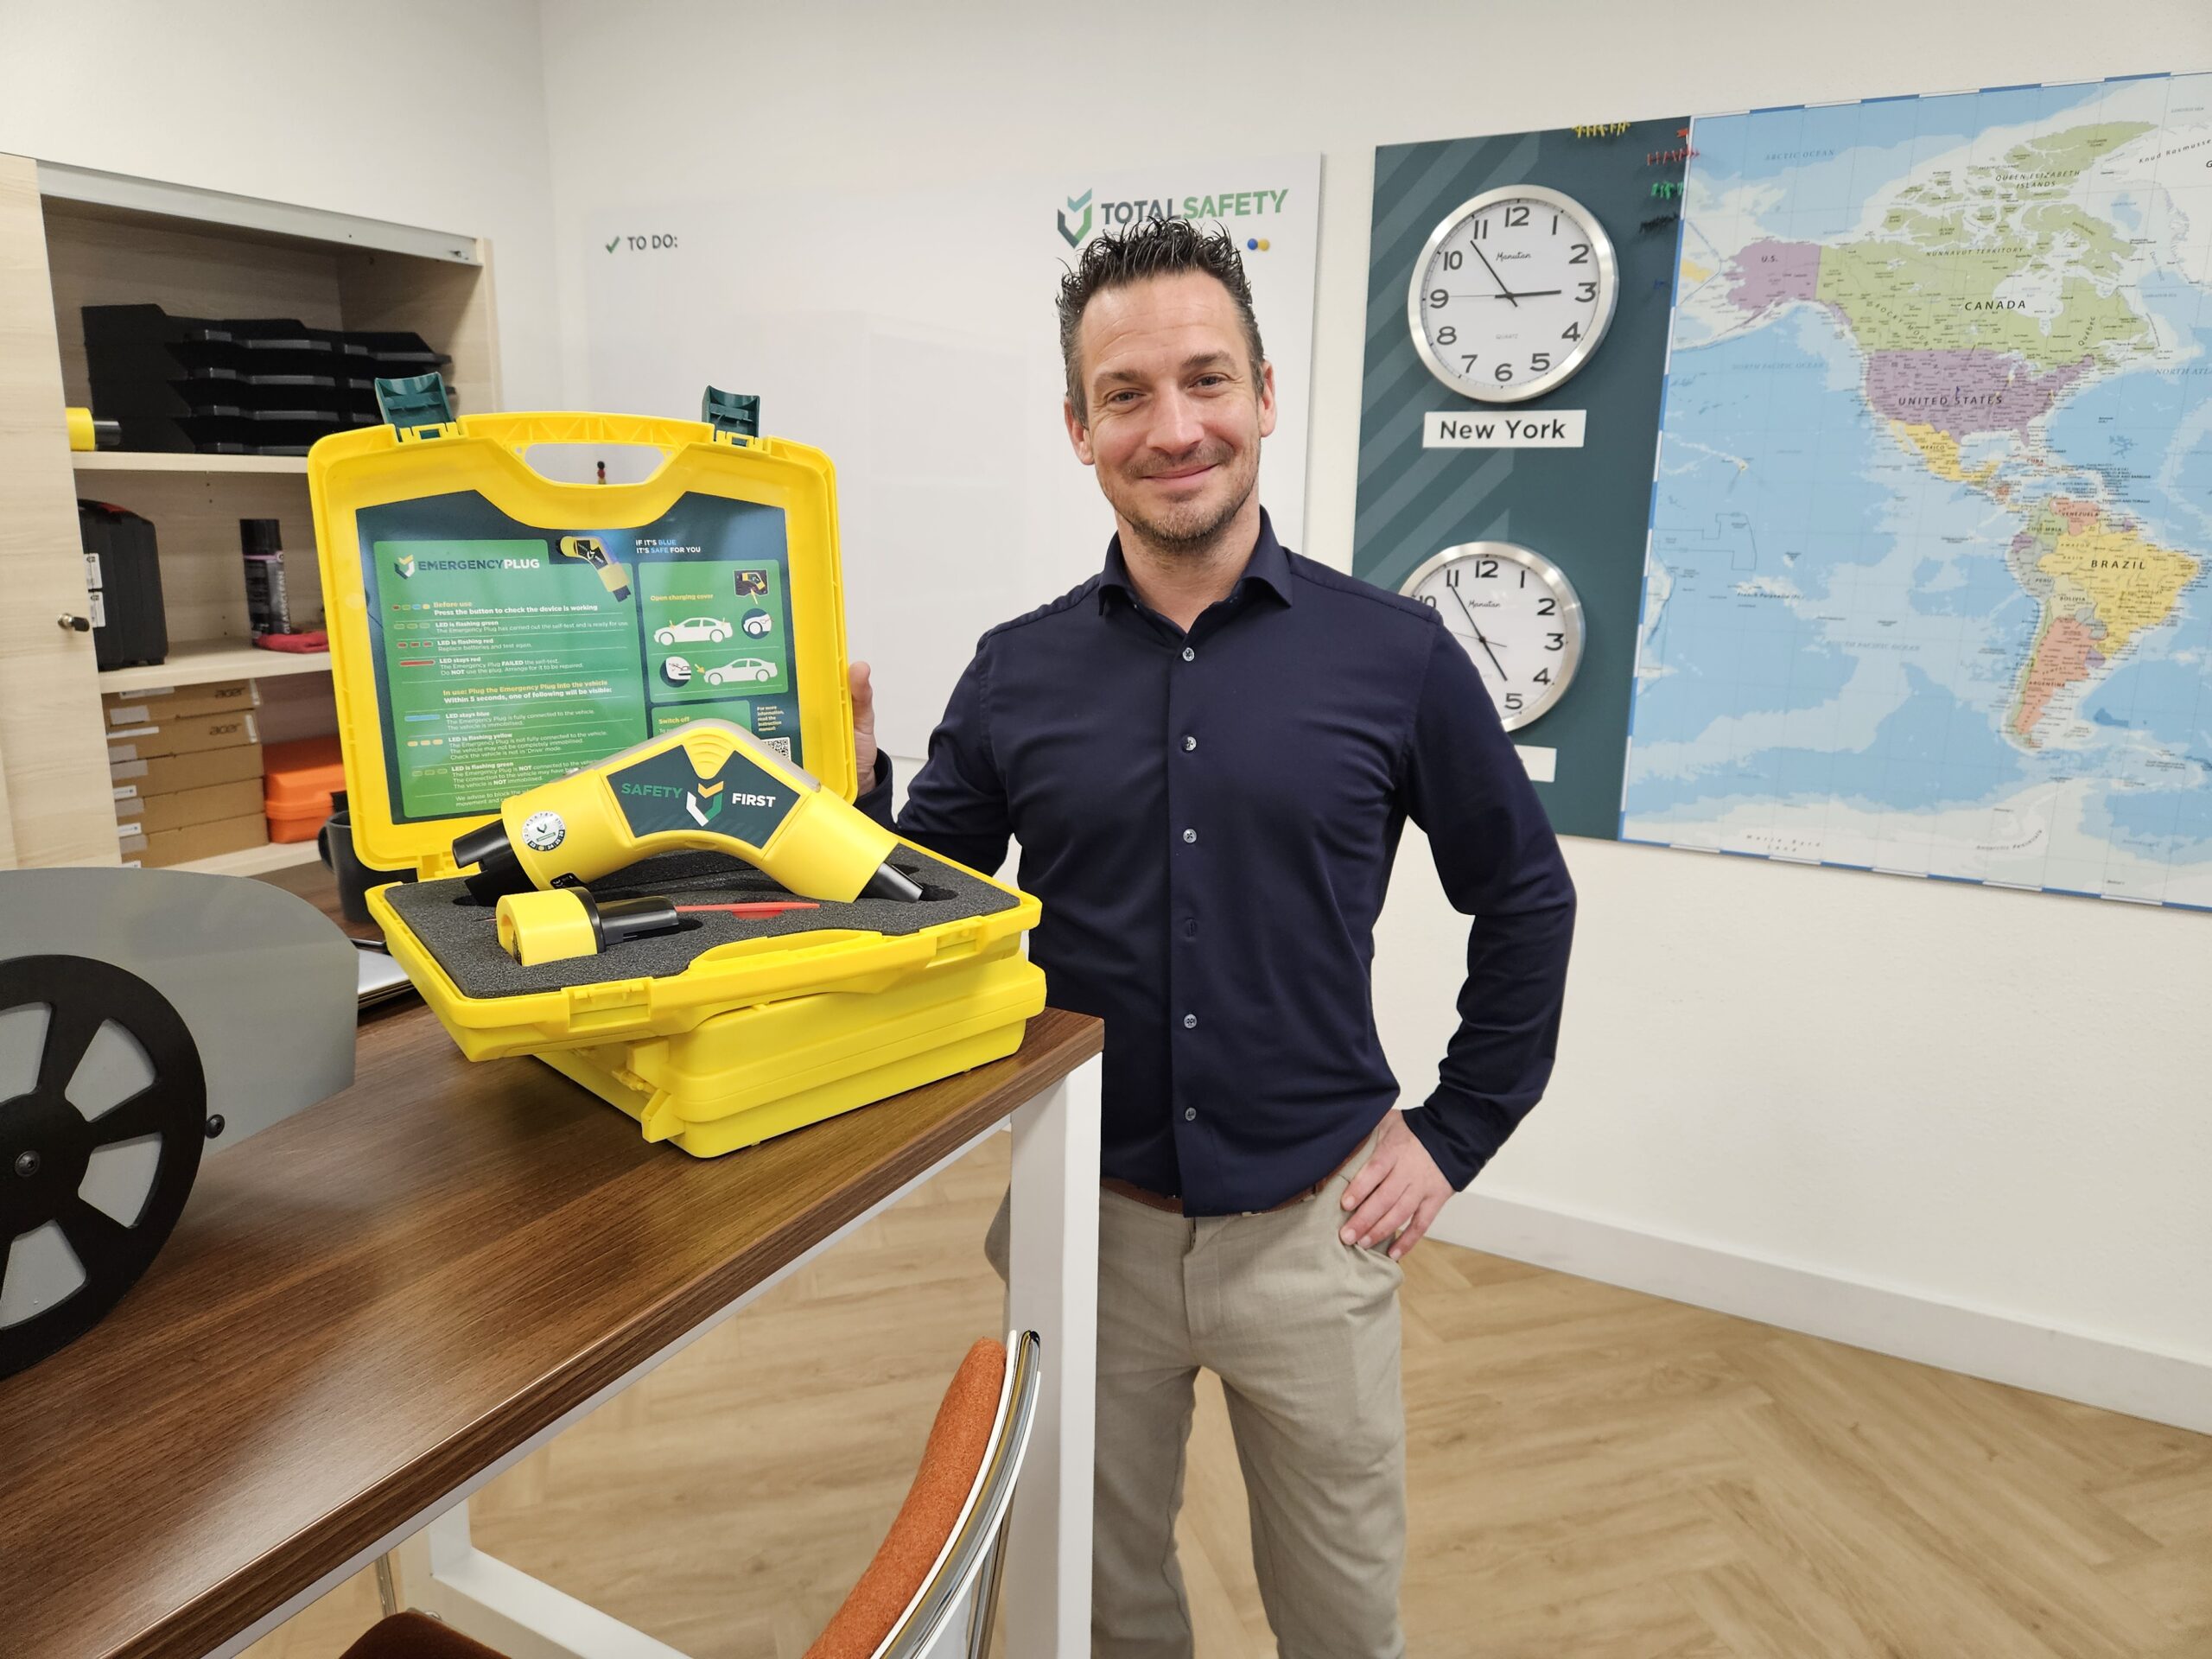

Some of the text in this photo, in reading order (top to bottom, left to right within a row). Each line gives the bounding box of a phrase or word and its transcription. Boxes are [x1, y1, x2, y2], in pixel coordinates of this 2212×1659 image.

[1765, 149, 1834, 161] ARCTIC OCEAN
[2016, 180, 2056, 188] ISLANDS
[2030, 170, 2081, 180] ELIZABETH
[1504, 207, 1530, 227] 12
[1551, 215, 1558, 235] 1
[1473, 219, 1488, 239] 11
[627, 233, 677, 251] TO DO:
[1442, 250, 1462, 270] 10
[1568, 244, 1589, 264] 2
[1429, 289, 1449, 308] 9
[1574, 282, 1597, 302] 3
[1964, 300, 2026, 310] CANADA
[1437, 326, 1457, 345] 8
[1561, 321, 1581, 342] 4
[1461, 354, 1478, 373] 7
[1529, 353, 1551, 372] 5
[1495, 363, 1513, 381] 6
[1898, 397, 2003, 405] UNITED STATES
[1440, 419, 1567, 440] New York
[418, 558, 540, 571] EMERGENCYPLUG
[1475, 560, 1498, 578] 12
[2091, 559, 2146, 570] BRAZIL
[1446, 569, 1459, 588] 11
[1520, 570, 1525, 588] 1
[1420, 595, 1436, 608] 0
[1537, 598, 1556, 615] 2
[1545, 632, 1564, 651] 3
[1533, 668, 1551, 685] 4
[1504, 693, 1523, 709] 5
[209, 723, 242, 735] acer
[620, 782, 776, 808] SAFETY FIRST
